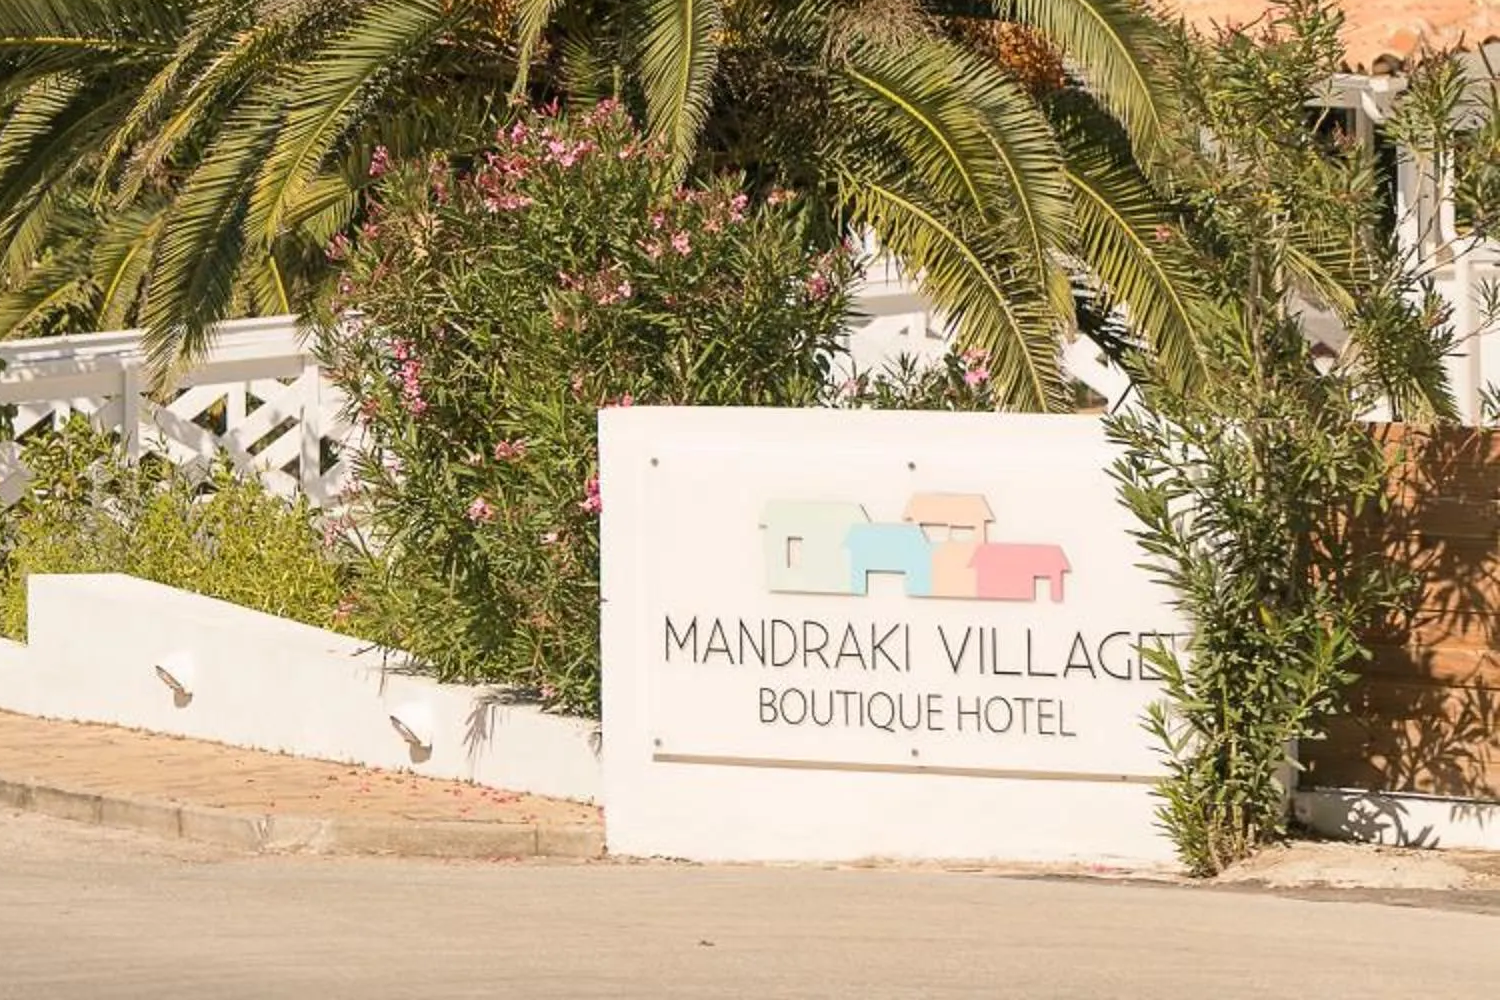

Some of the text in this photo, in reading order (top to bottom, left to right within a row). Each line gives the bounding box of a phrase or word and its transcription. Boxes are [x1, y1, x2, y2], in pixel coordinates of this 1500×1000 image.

[664, 615, 910, 672] MANDRAKI
[759, 687, 1077, 737] BOUTIQUE HOTEL
